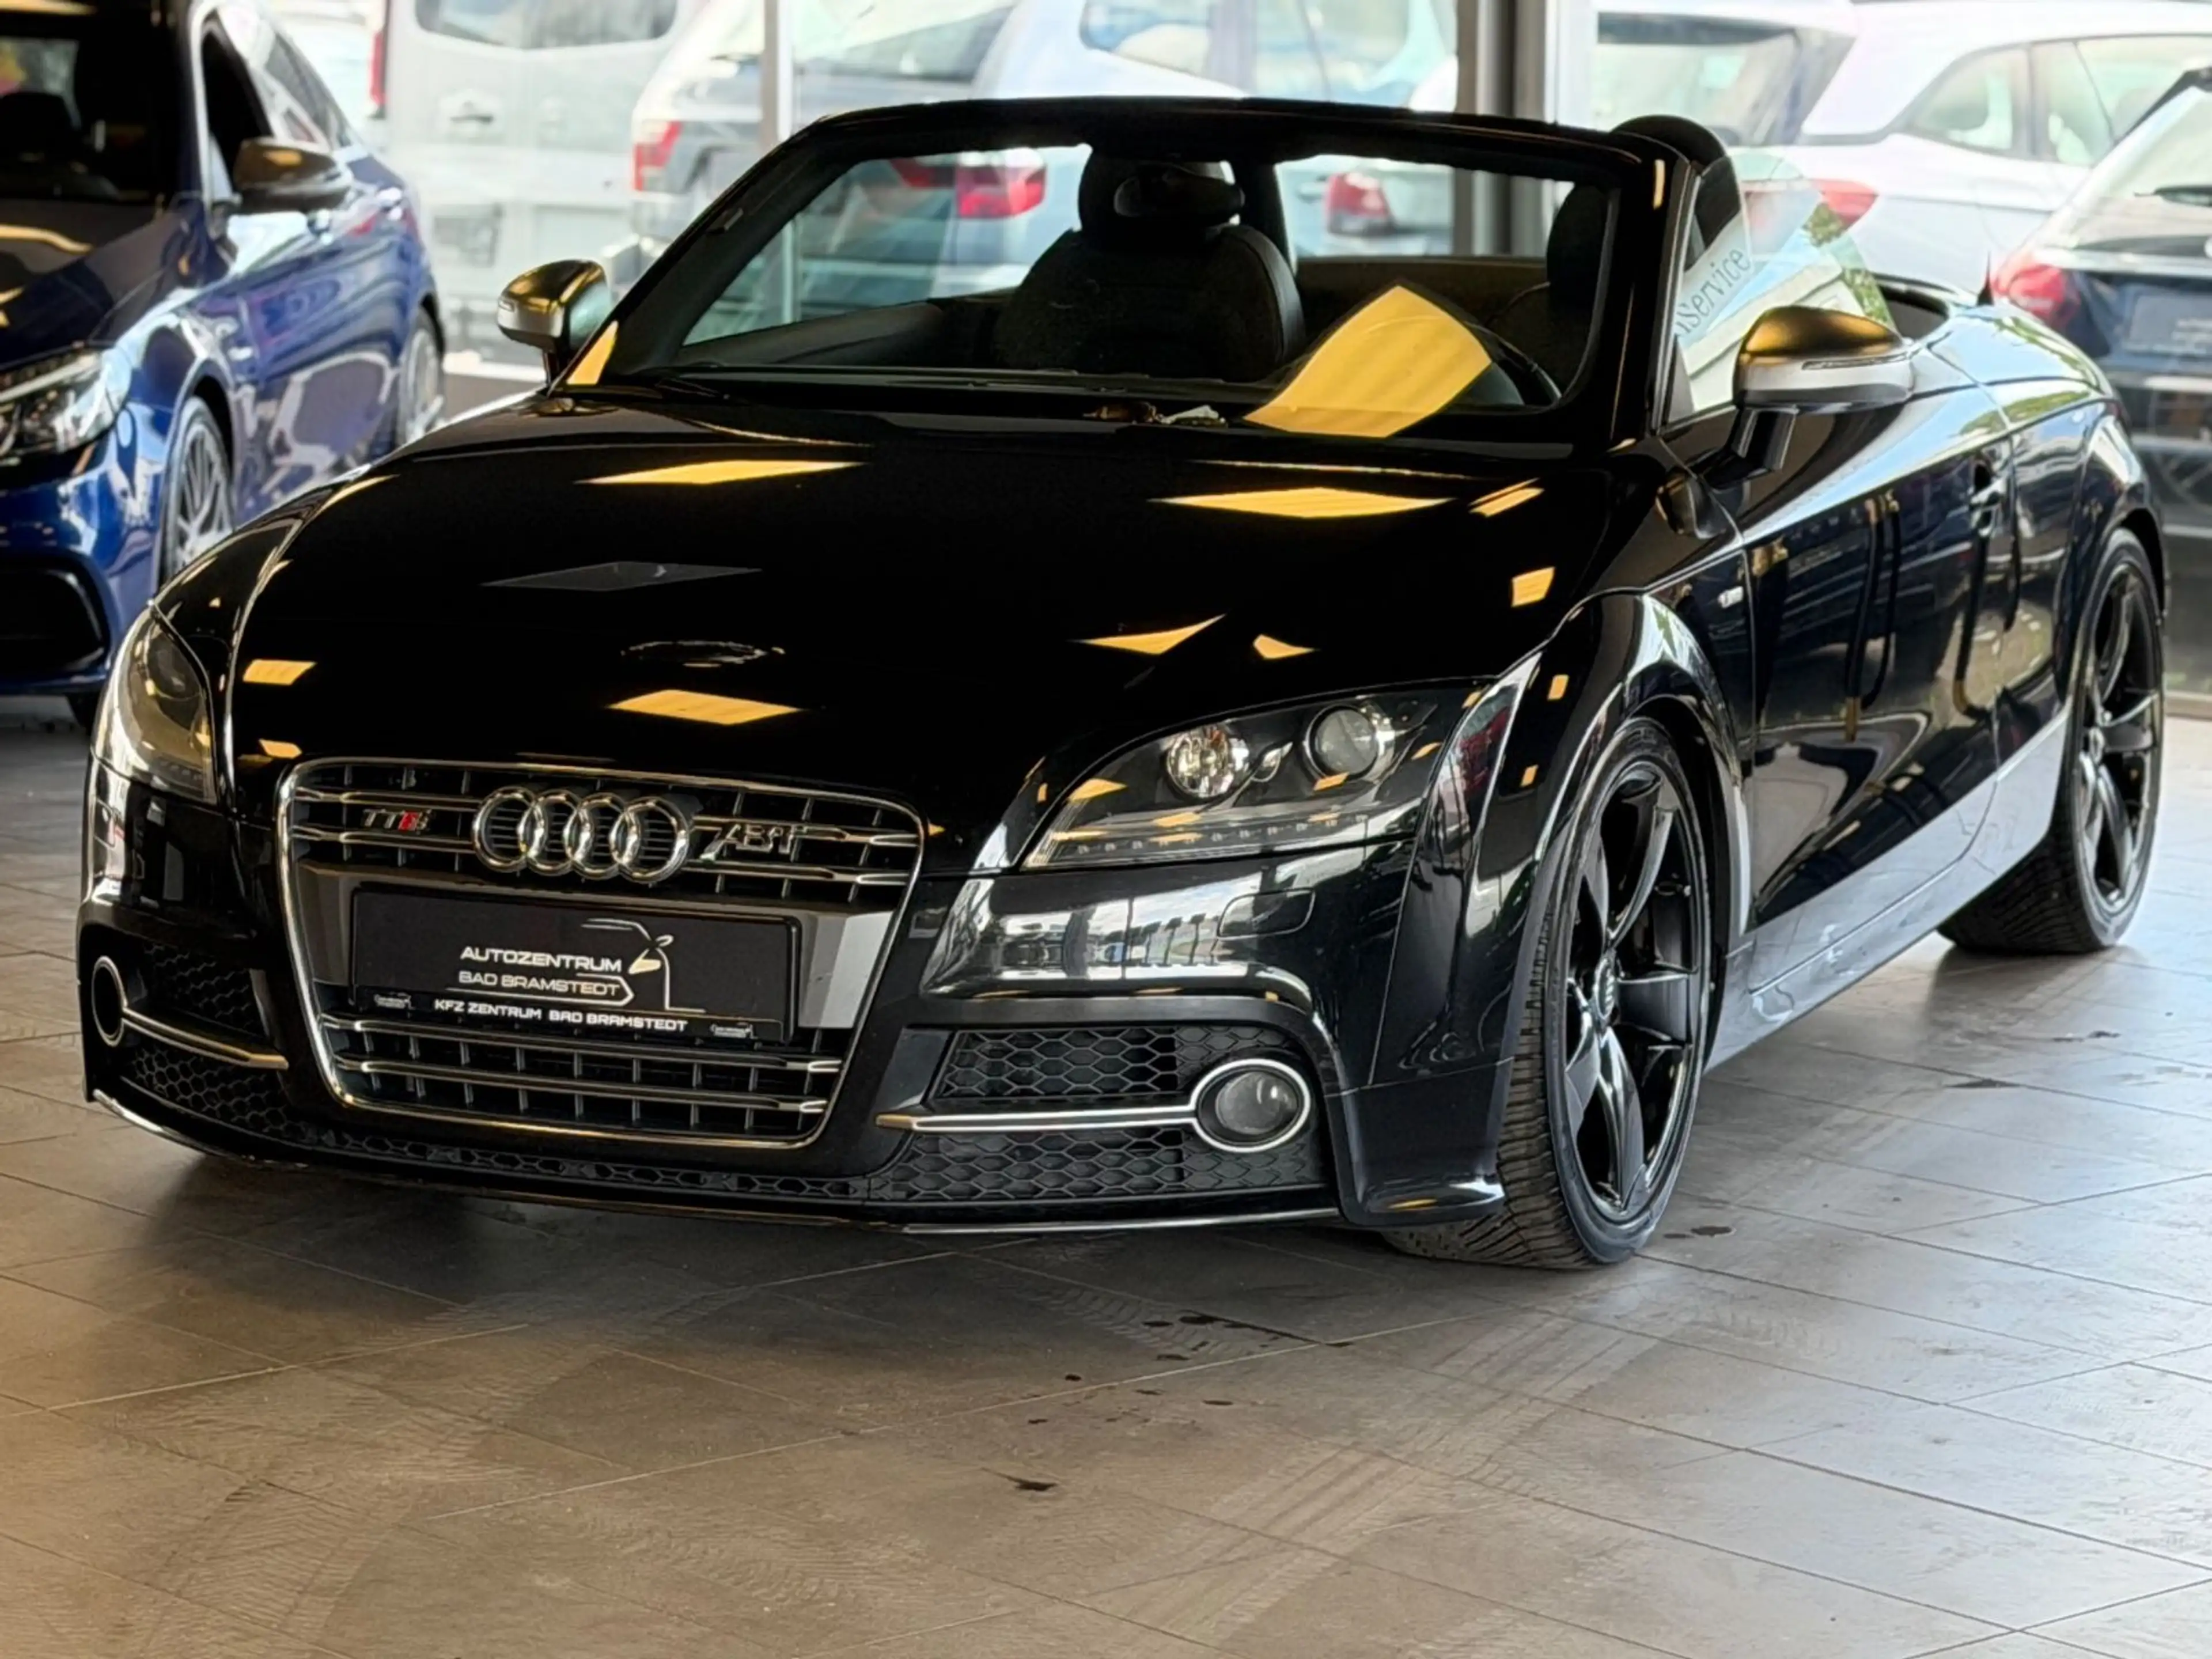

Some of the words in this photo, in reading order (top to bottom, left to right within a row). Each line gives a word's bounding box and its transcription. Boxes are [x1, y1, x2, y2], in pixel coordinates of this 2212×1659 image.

[460, 946, 622, 972] AUTOZENTRUM
[459, 971, 498, 986] BAD
[502, 975, 620, 996] BRAMSTEDT
[434, 998, 465, 1012] KFZ
[468, 1002, 543, 1020] ZENTRUM
[548, 1009, 582, 1023] BAD
[586, 1013, 688, 1032] BRAMSTEDT
